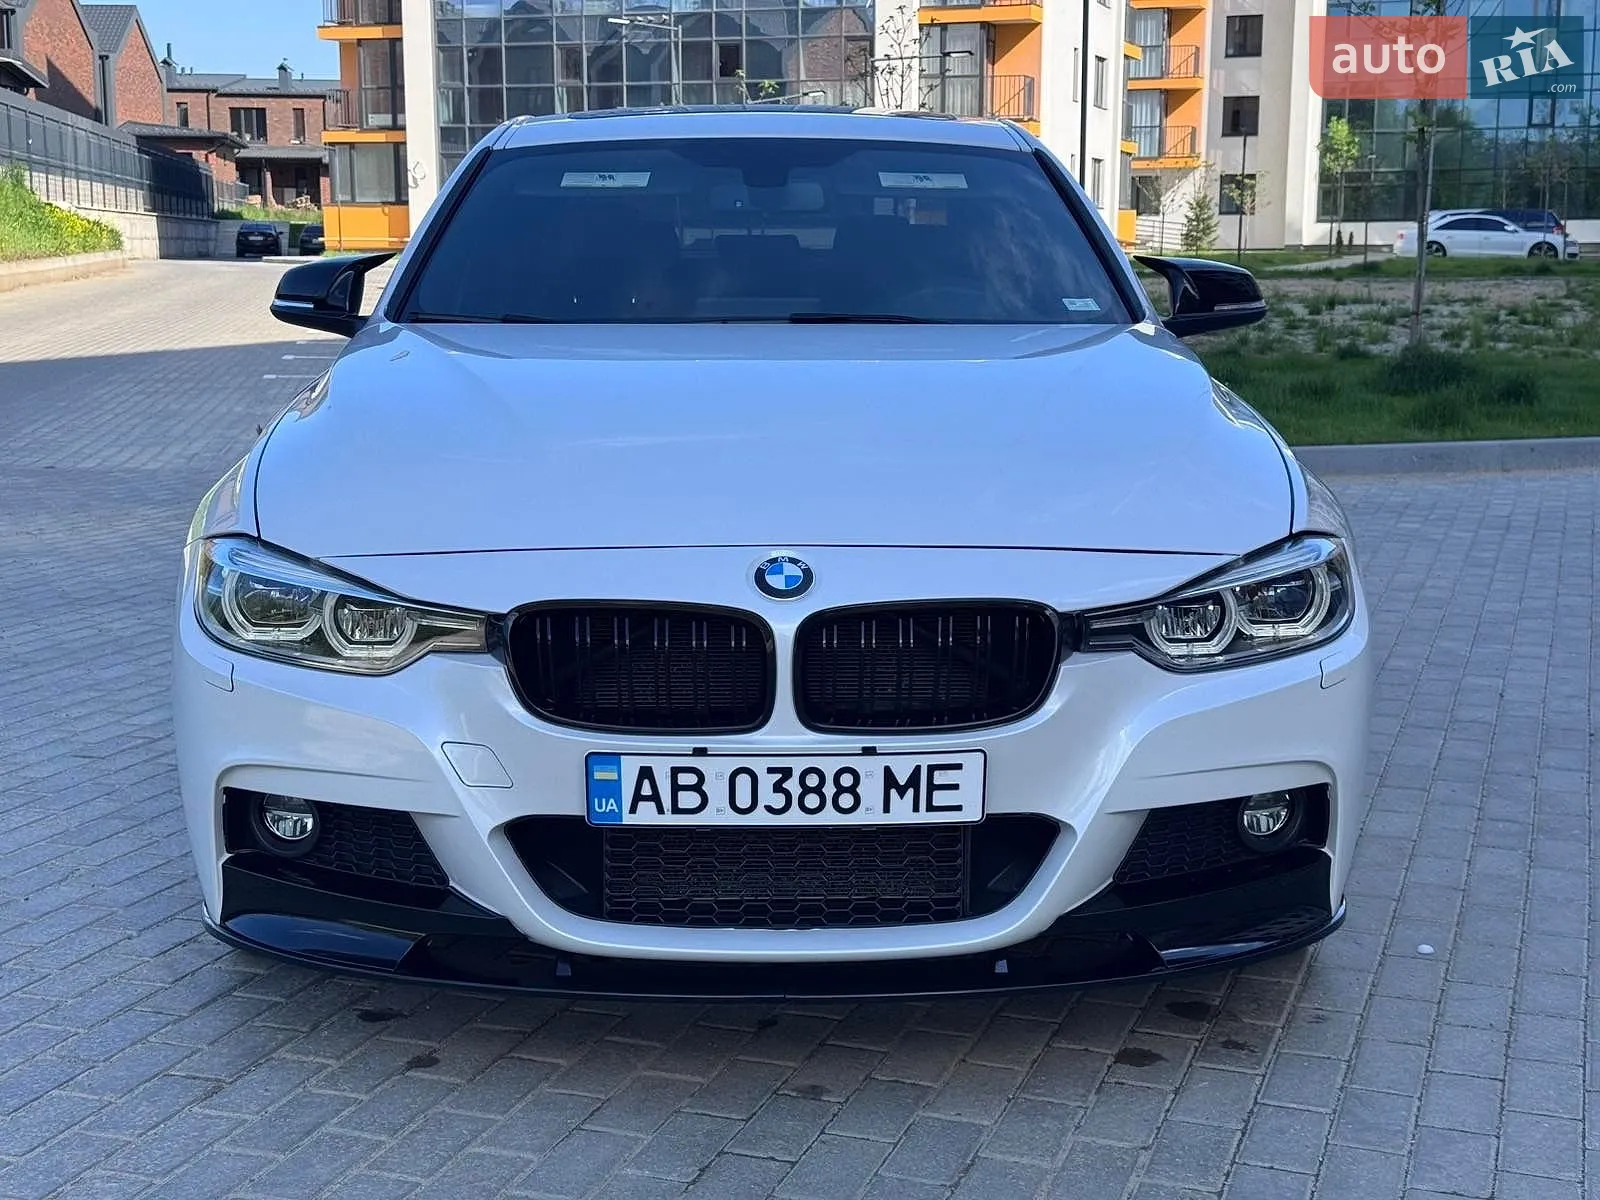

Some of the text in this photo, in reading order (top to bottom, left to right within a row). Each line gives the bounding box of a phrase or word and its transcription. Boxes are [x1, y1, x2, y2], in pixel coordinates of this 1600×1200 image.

[760, 557, 808, 569] BMW
[628, 763, 964, 815] AB 0388 ME
[594, 798, 619, 813] UA
